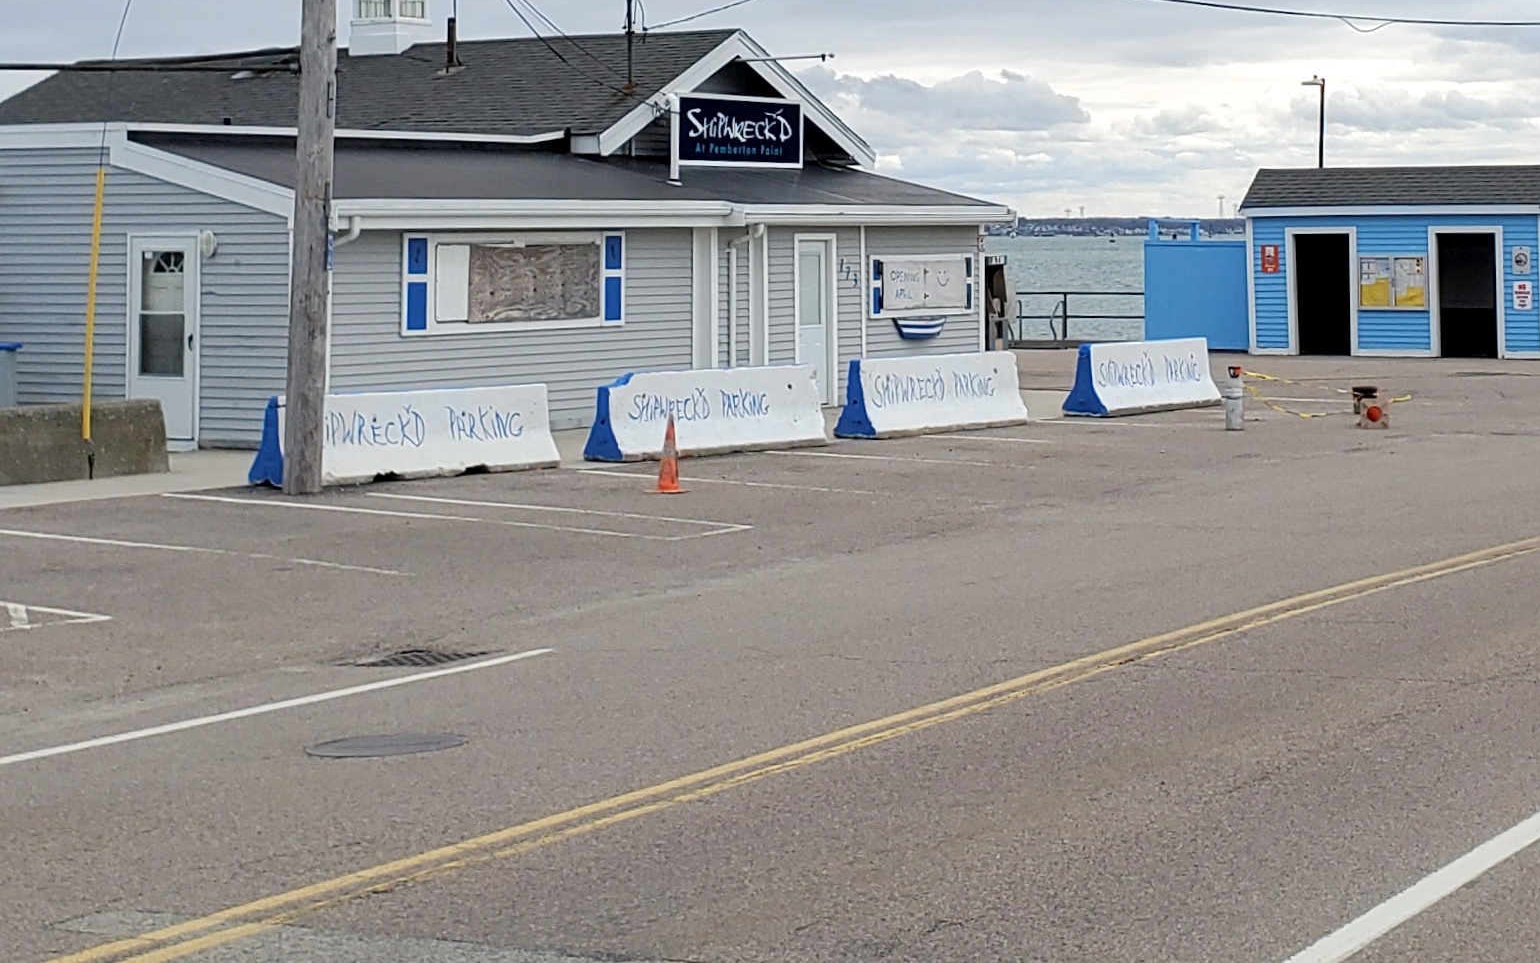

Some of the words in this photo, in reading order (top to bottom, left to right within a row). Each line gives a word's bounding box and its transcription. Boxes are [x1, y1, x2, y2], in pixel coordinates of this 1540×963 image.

[709, 143, 757, 155] Pemberton
[760, 144, 783, 156] Point
[719, 388, 770, 419] PARKING
[324, 404, 426, 448] IPWRECK'D
[444, 405, 524, 442] PARKING
